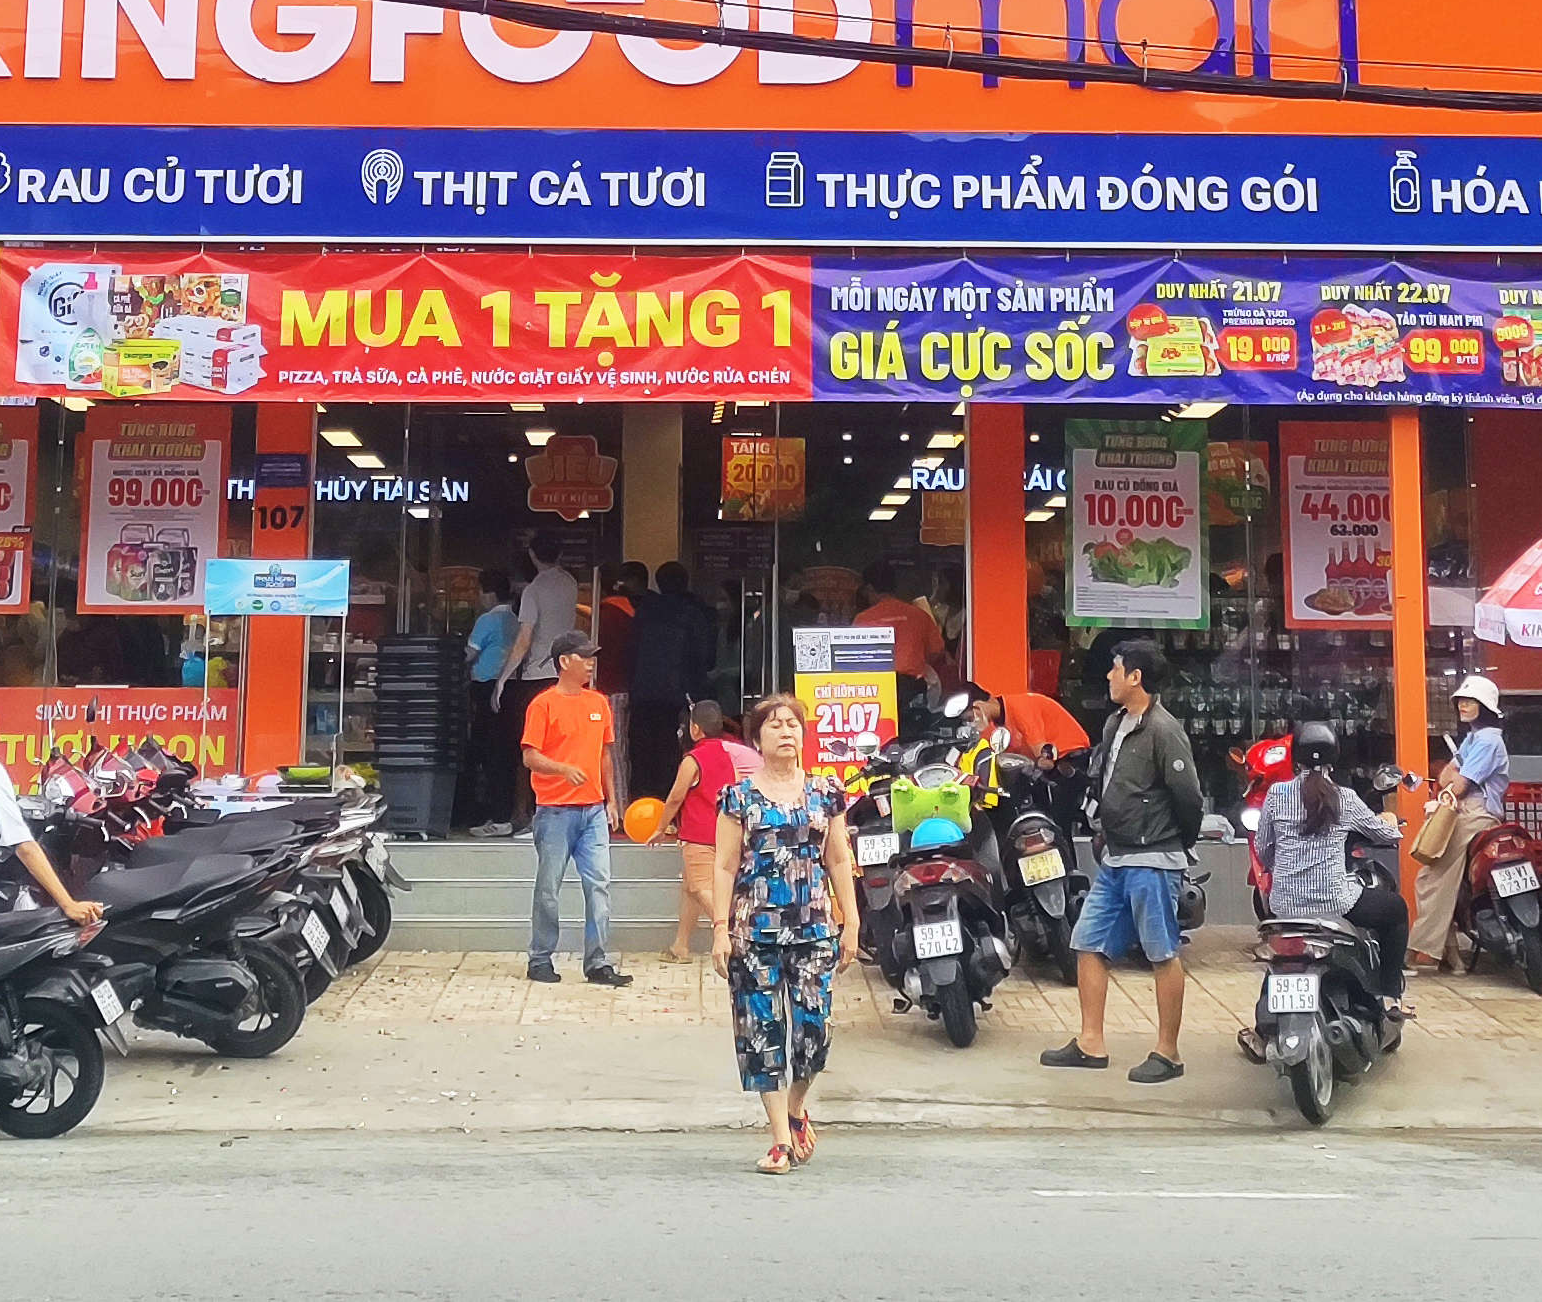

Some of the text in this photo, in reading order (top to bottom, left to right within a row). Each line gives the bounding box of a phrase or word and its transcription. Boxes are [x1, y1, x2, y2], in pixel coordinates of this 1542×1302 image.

[17, 156, 302, 205] RAU CỦ TƯƠI
[413, 161, 706, 216] THỊT CÁ TƯƠI
[816, 154, 1318, 220] THỰC PHẨM ĐÓNG GÓI
[1432, 165, 1529, 215] HÓA
[831, 276, 1114, 320] MỖI NGÀY MỘT SẢN PHẨM
[1157, 279, 1281, 302] DUY NHẤT 21.07
[1321, 281, 1450, 304] DUY NHẤT 22.07
[1499, 290, 1528, 305] DUY
[279, 272, 792, 367] MUA 1 TẶNG 1
[1440, 315, 1462, 326] NAM
[1465, 315, 1483, 326] PHI
[1497, 323, 1529, 342] 900G
[830, 316, 1115, 397] GIÁ CỰC SỐC
[1227, 337, 1290, 362] 19.000
[1410, 338, 1478, 364] 99.000
[278, 366, 790, 389] PIZZA, TRÀ SỮA, CÀ PHÊ, NƯỚC GIẶT GIẤY VỆ SINH, NƯỚC RỬA CHÉN
[913, 468, 964, 490] RAU
[1094, 480, 1115, 492] RAU
[1161, 478, 1179, 493] GIÁ
[259, 506, 305, 530] 107
[118, 701, 167, 726] THỰC
[172, 697, 227, 722] PHẨM
[816, 703, 881, 733] 21.07
[921, 929, 953, 941] 59-X3
[919, 939, 959, 956] 570.42
[1276, 978, 1310, 992] 59-C3
[1271, 994, 1315, 1010] 011.59
